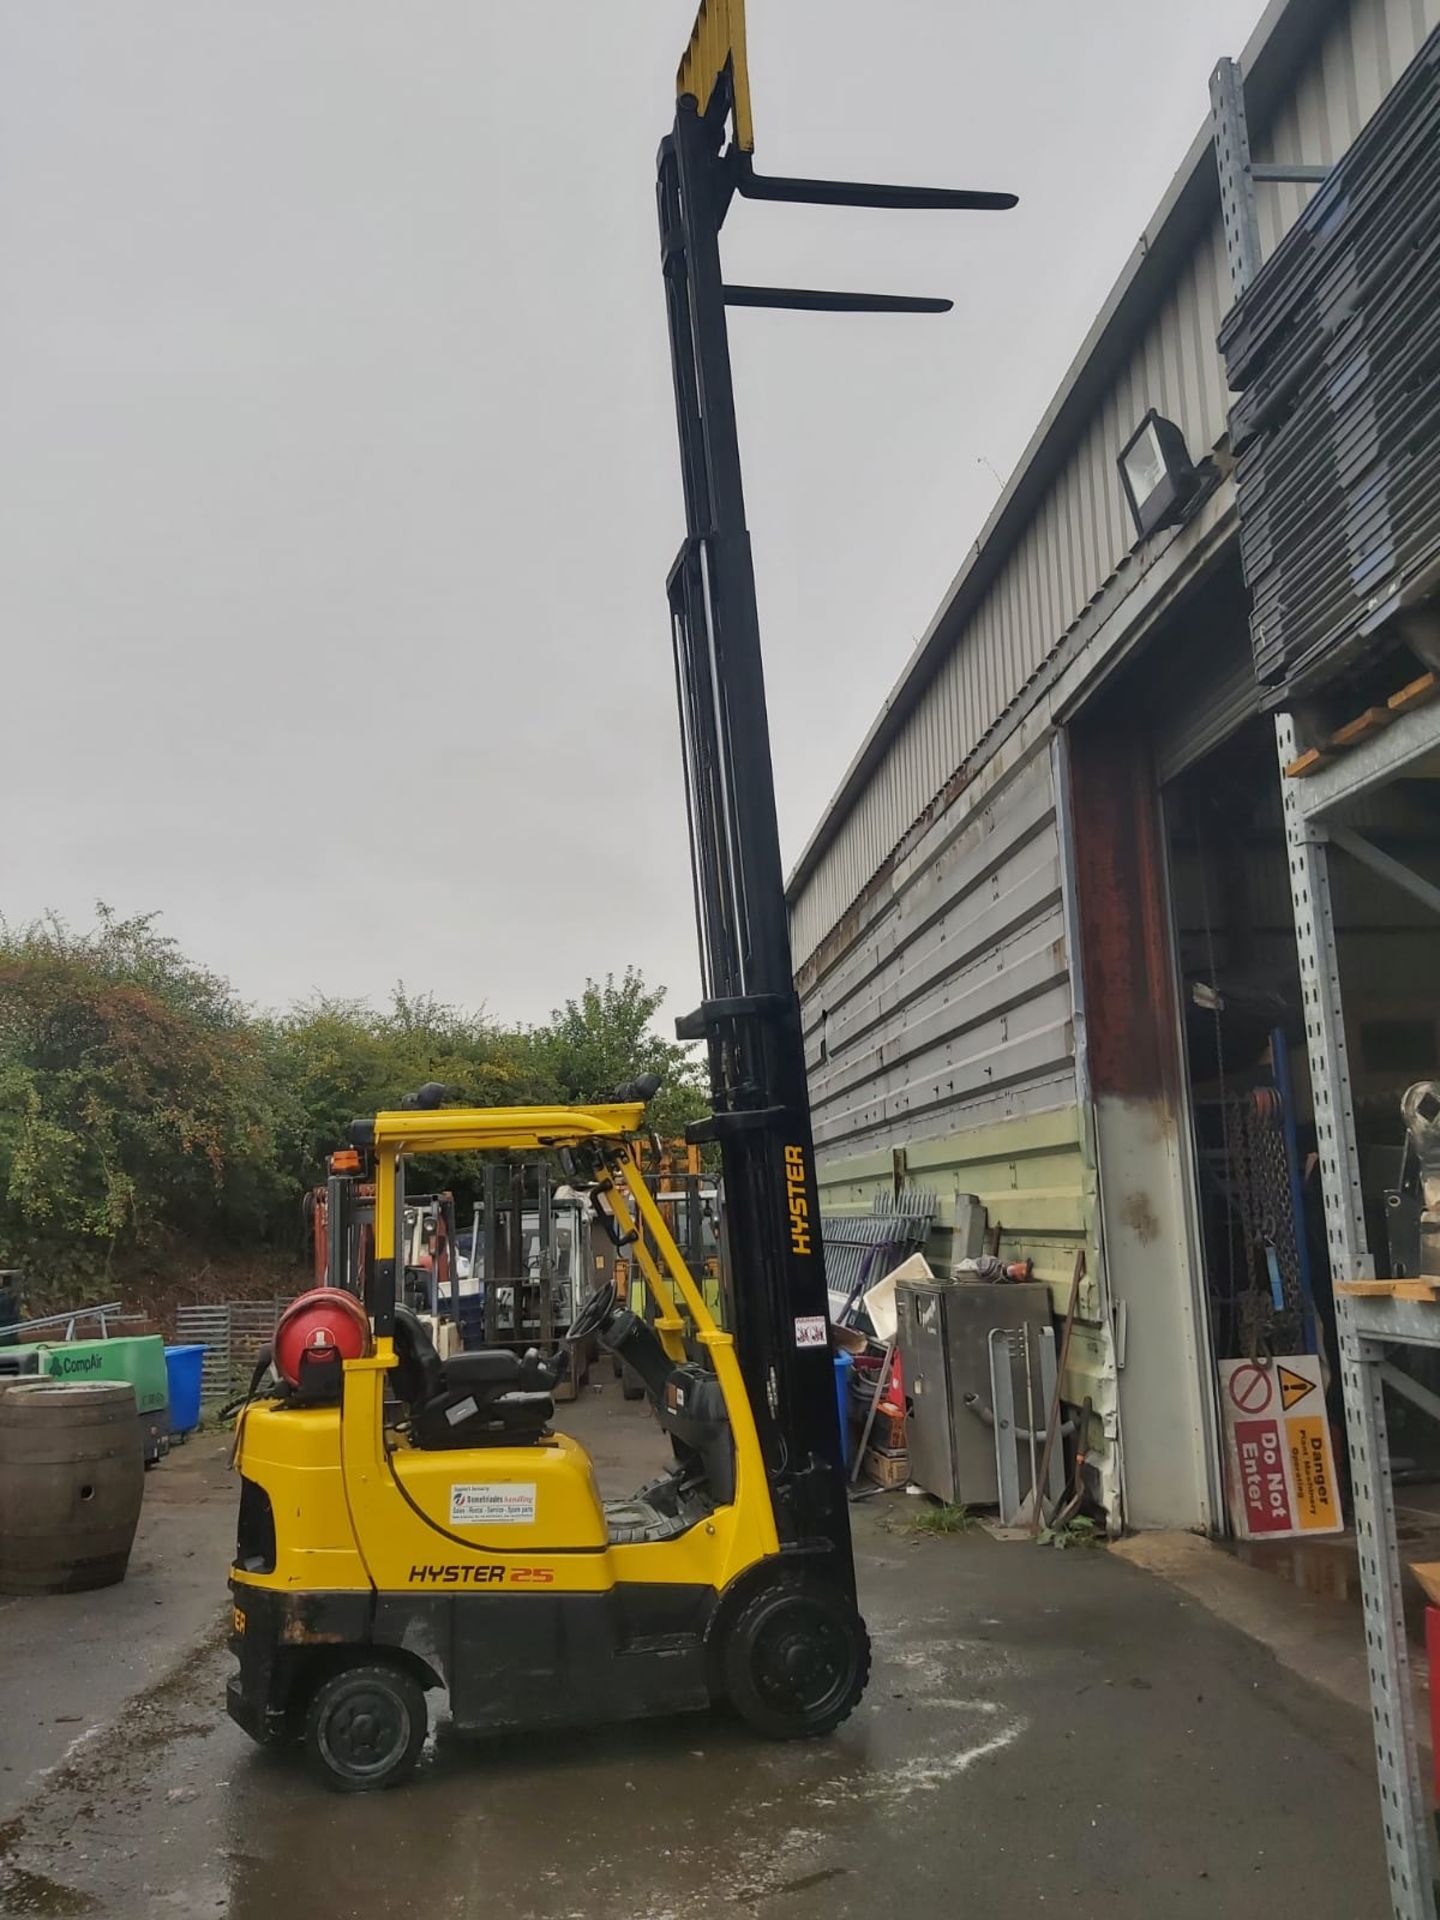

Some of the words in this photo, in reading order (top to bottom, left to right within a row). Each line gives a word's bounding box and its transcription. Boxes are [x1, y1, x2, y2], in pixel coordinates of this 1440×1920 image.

[784, 1145, 811, 1254] HYSTER
[63, 1353, 102, 1374] CompAir
[1261, 1432, 1277, 1465] Do
[1300, 1429, 1309, 1456] Plant
[1242, 1442, 1263, 1511] Enter
[1267, 1473, 1287, 1518] Not
[1292, 1447, 1304, 1499] Operating
[1304, 1460, 1316, 1515] Machinery
[1310, 1437, 1329, 1506] Danger
[408, 1565, 506, 1582] HYSTER
[510, 1568, 554, 1583] 25
